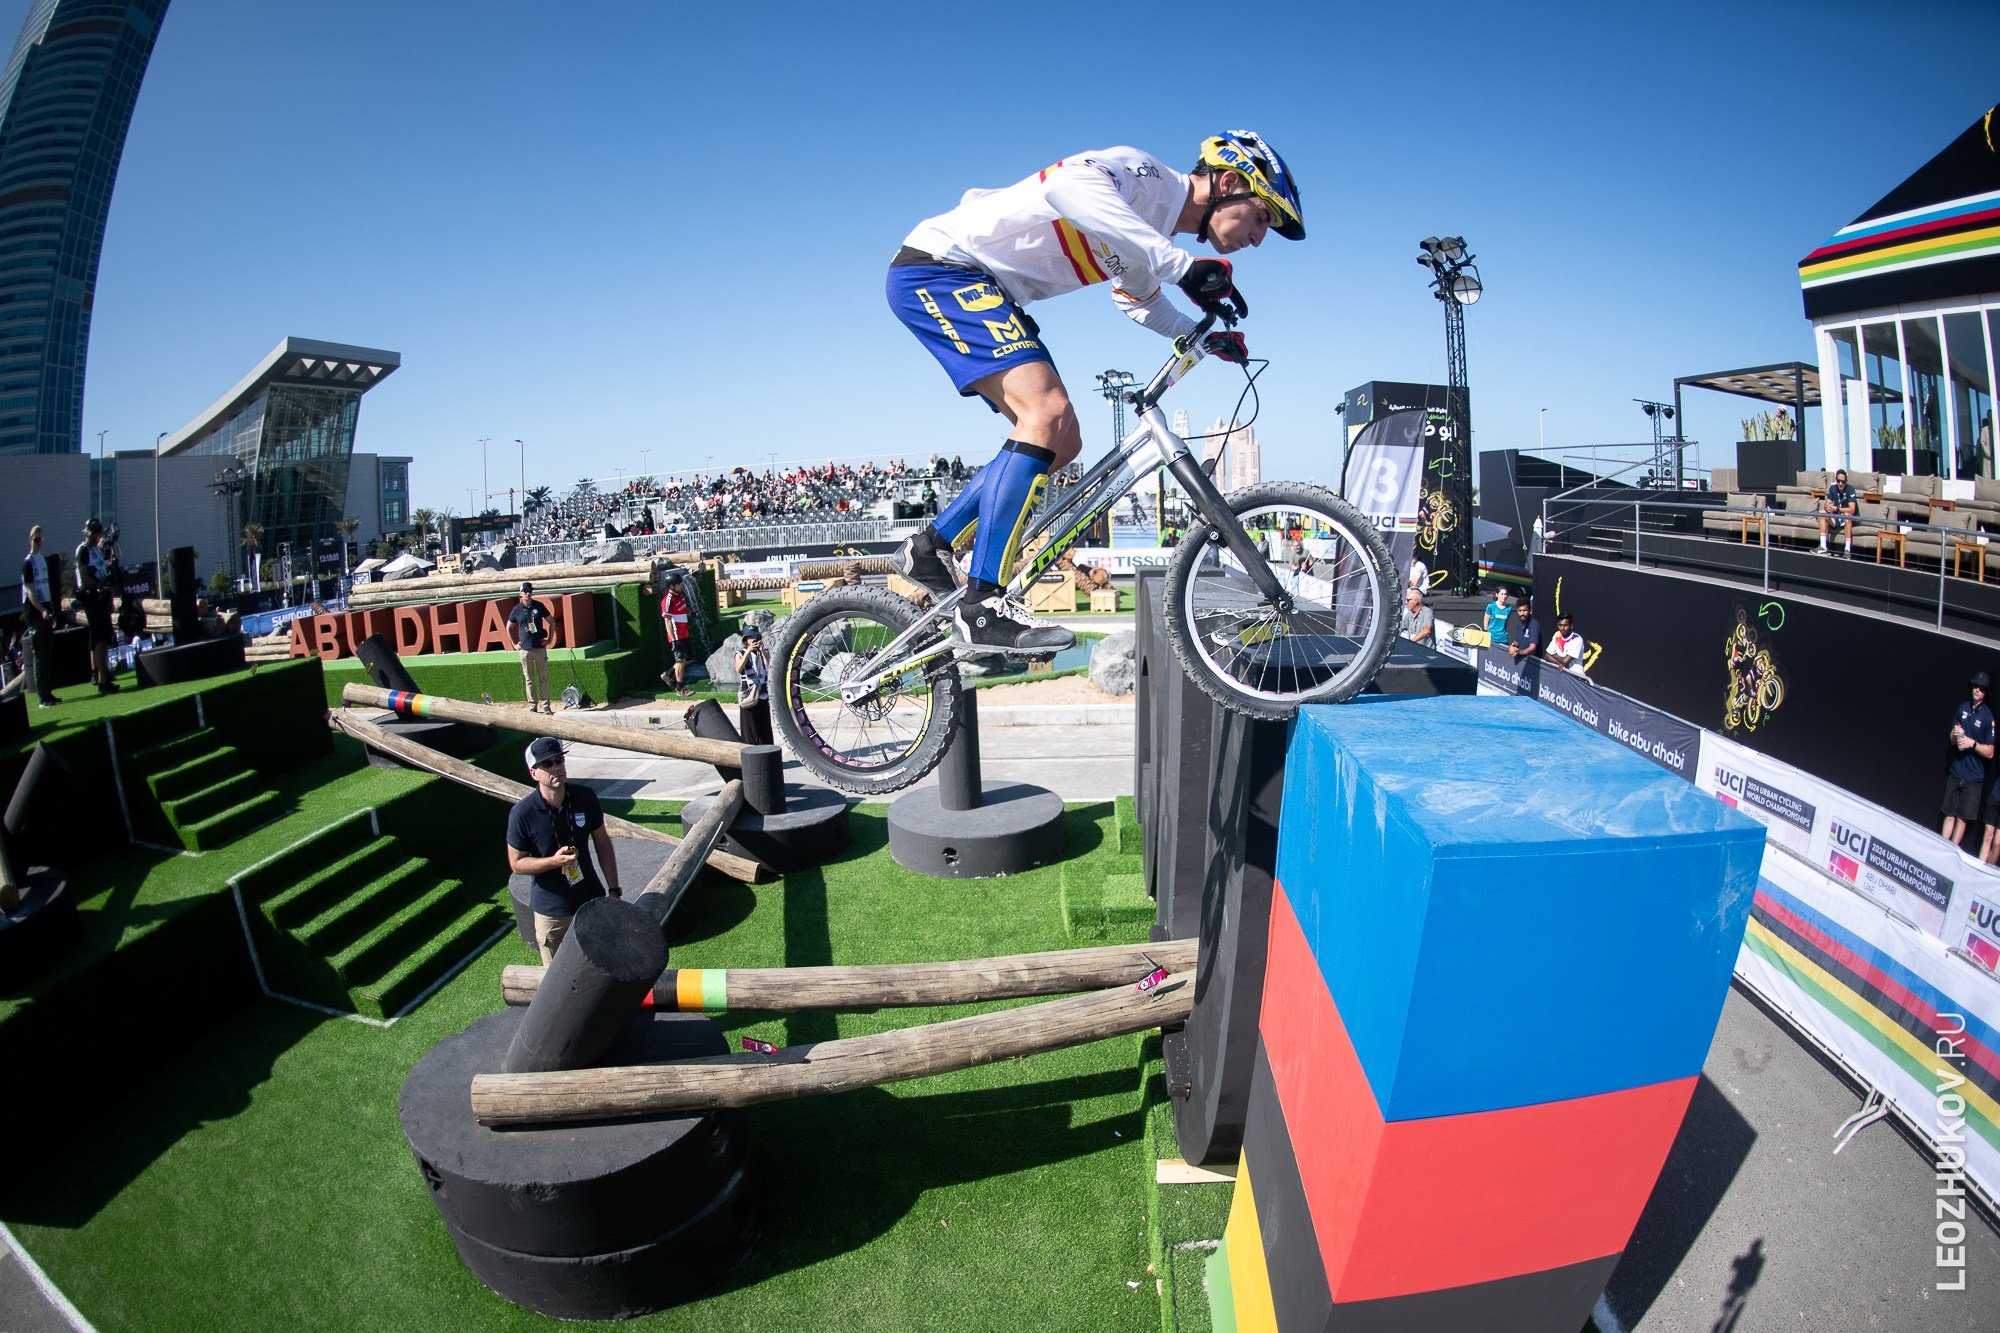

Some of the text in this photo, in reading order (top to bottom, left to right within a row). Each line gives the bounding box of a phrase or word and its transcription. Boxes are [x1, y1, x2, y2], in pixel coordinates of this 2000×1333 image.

[1217, 147, 1256, 175] WD-40
[992, 340, 1040, 359] COMAS
[1369, 457, 1400, 504] 3
[1369, 515, 1396, 528] UCI
[289, 610, 373, 660] ABU
[1484, 659, 1498, 675] bike
[1498, 665, 1511, 682] abu
[1511, 671, 1532, 692] dhabi
[1539, 683, 1556, 704] bike
[1555, 693, 1572, 712] abu
[1572, 702, 1599, 727] dhabi
[1608, 718, 1685, 770] bike abu dhabi
[1719, 769, 1744, 794] UCI
[1747, 781, 1802, 812] 2024 URBAN CYCLING
[1746, 791, 1811, 828] WORLD CHAMPIONSHIPS
[1836, 825, 1867, 856] UCI
[1869, 852, 1946, 905] WORLD CHAMPIONSHIPS
[1871, 843, 1937, 886] 2024 URBAN CYCLING
[1863, 882, 1875, 895] UAE
[1865, 871, 1897, 896] ABU DHABI
[1977, 904, 2000, 938] UC
